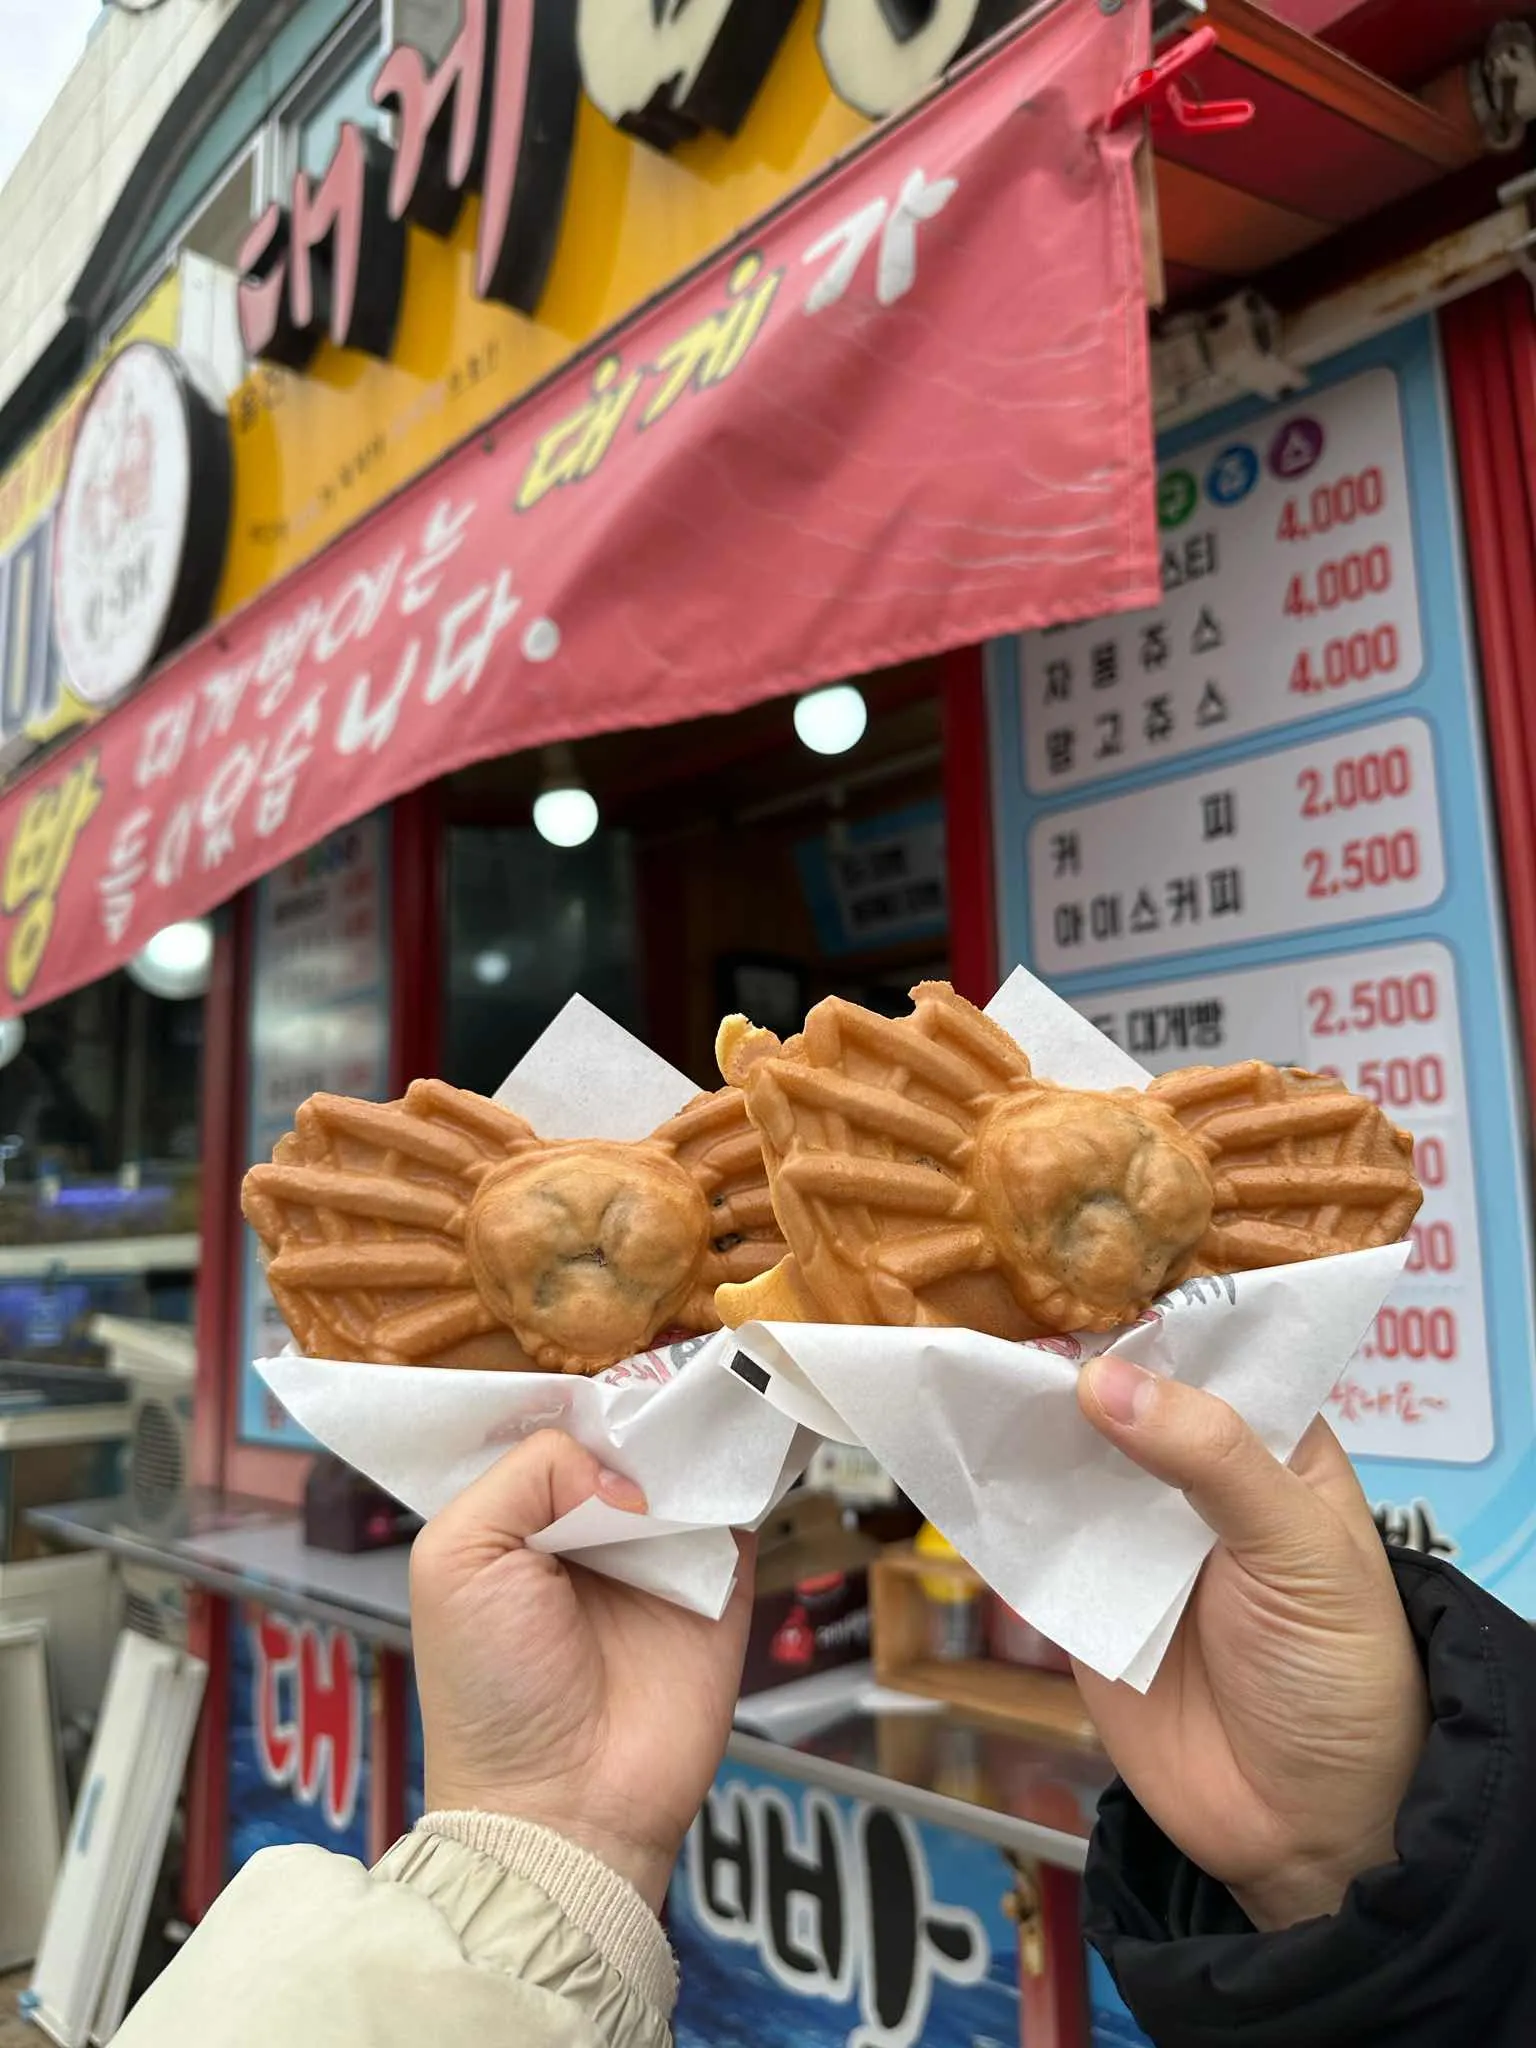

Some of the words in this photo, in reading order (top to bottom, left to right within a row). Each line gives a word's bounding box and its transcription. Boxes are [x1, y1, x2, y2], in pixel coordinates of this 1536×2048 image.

[1275, 464, 1384, 542] 4.000
[1283, 543, 1392, 616] 4.000
[1288, 624, 1399, 697] 4.000
[1297, 746, 1412, 819] 2.000
[1052, 864, 1243, 949] 아이스커피
[1303, 828, 1420, 899] 2.500
[1307, 971, 1438, 1037] 2.500
[1318, 1052, 1446, 1107] 500
[1363, 1306, 1457, 1362] .000
[255, 1608, 358, 1824] 대
